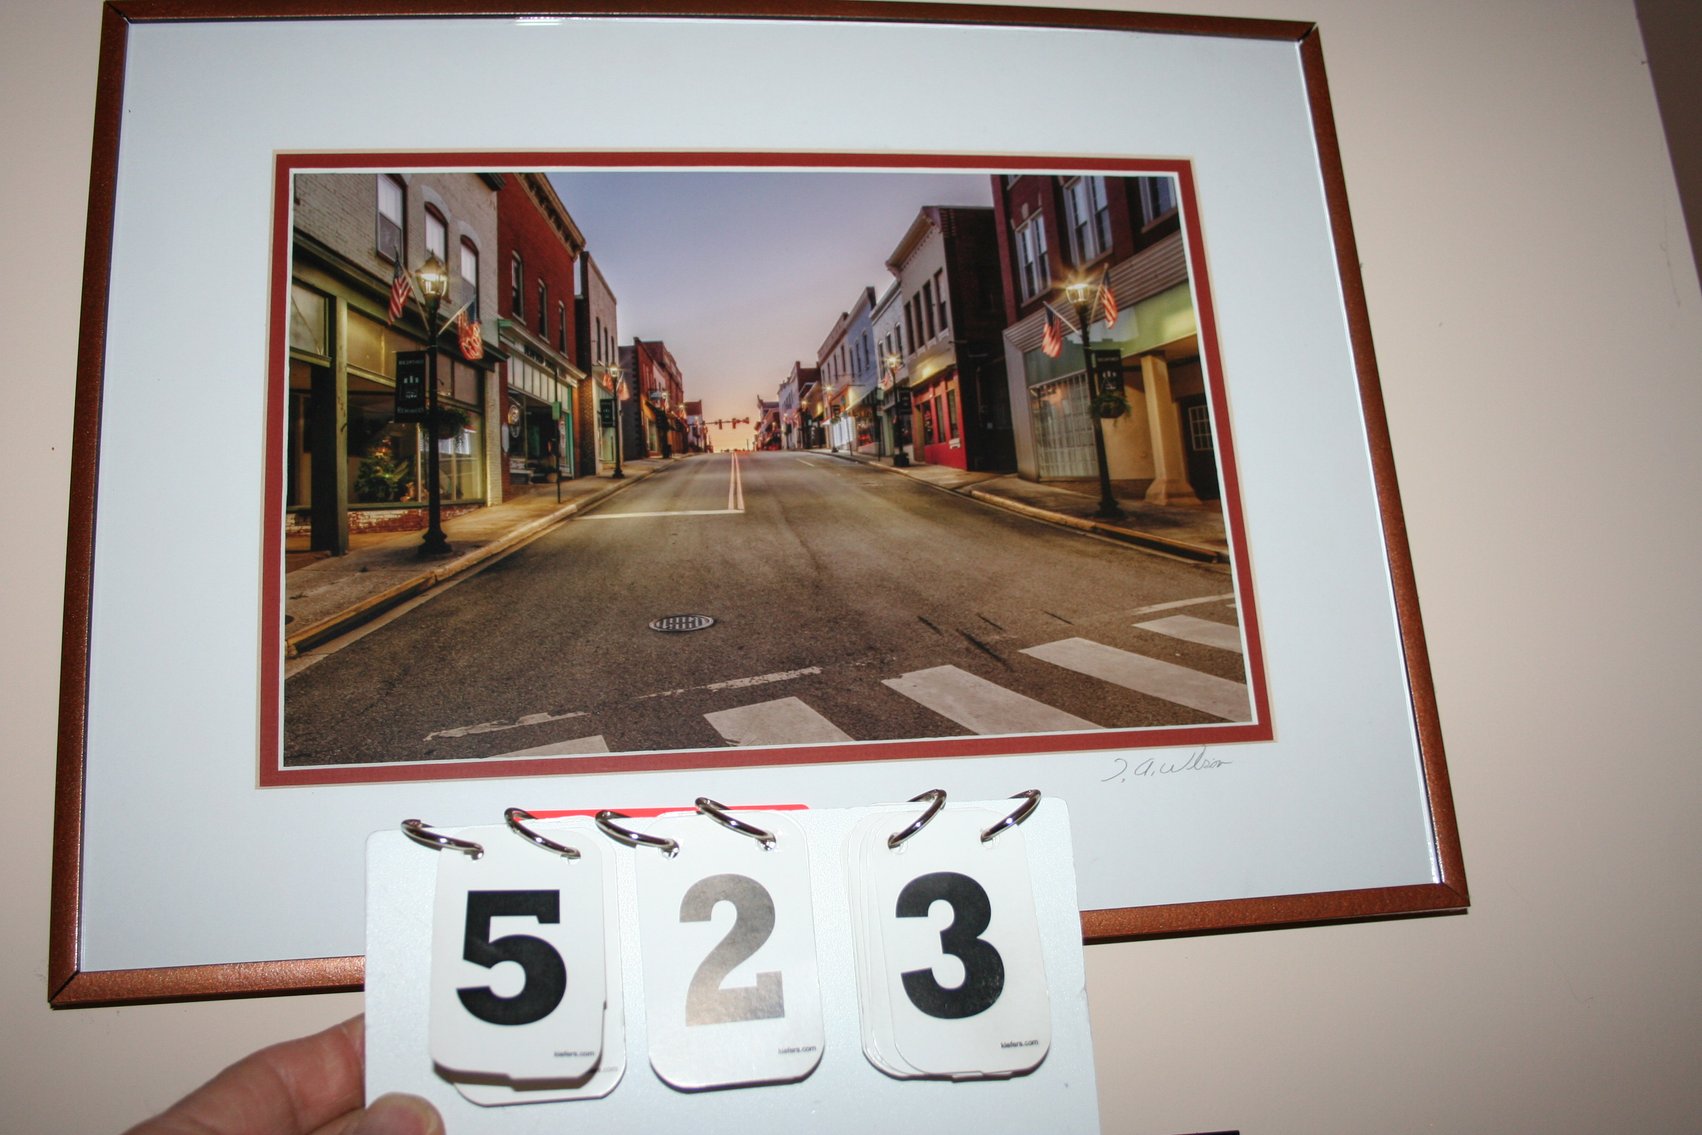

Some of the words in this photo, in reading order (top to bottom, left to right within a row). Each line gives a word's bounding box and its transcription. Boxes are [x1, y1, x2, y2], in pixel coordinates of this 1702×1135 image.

[456, 889, 567, 1026] 5
[679, 872, 786, 1027] 2
[895, 871, 1006, 1020] 3
